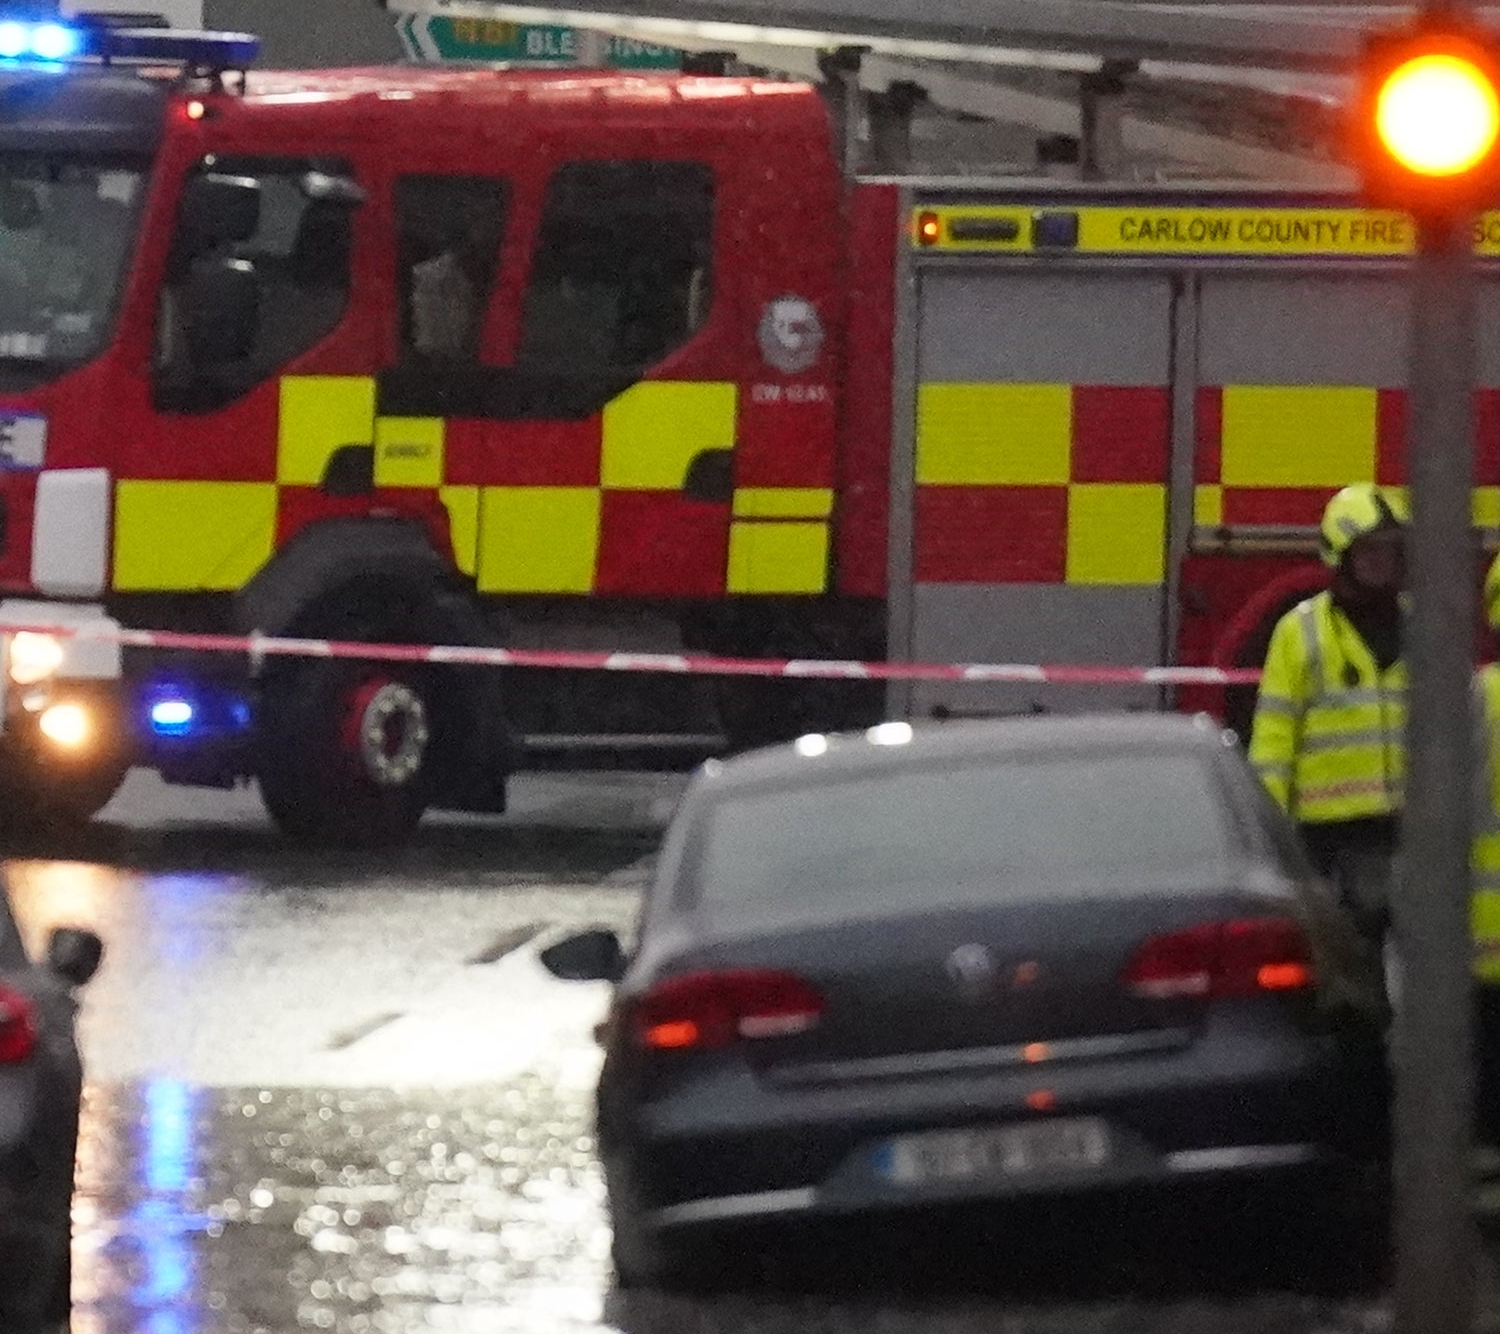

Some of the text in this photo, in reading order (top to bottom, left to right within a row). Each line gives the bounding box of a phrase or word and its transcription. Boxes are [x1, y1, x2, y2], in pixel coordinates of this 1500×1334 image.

[1119, 217, 1230, 243] CARLOW
[1237, 218, 1341, 244] COUNTY
[1349, 219, 1405, 244] FIRE
